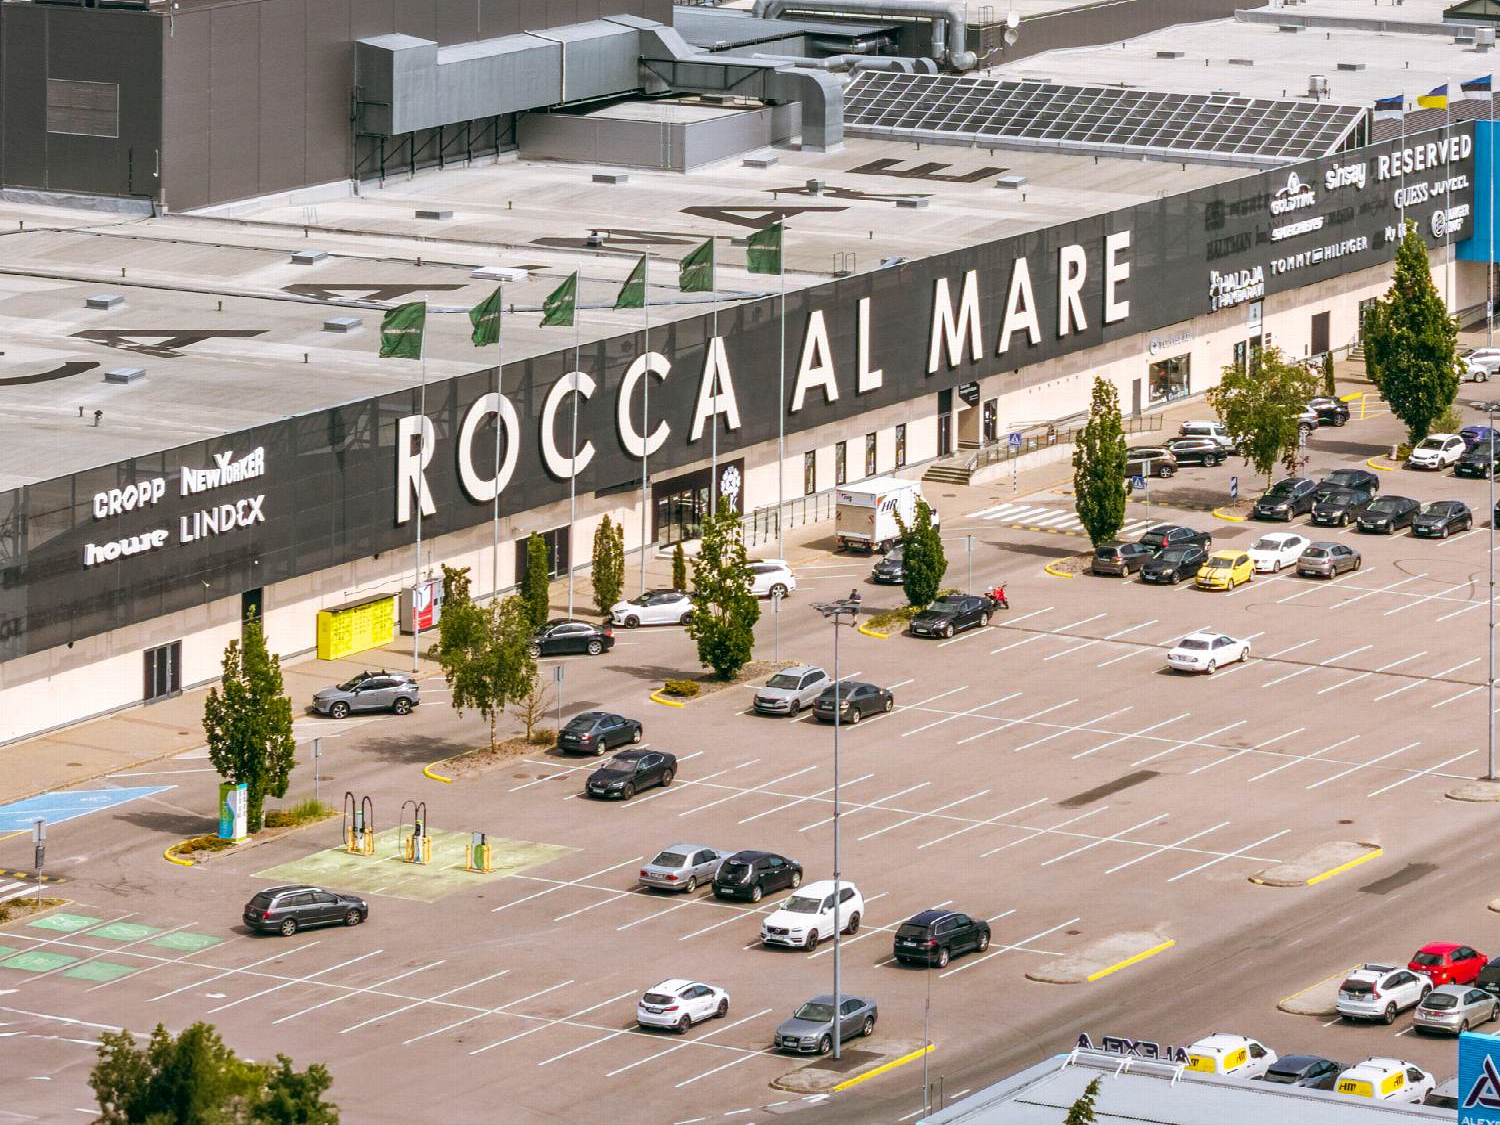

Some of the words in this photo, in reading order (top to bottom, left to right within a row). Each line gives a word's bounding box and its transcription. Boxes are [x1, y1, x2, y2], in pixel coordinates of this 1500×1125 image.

[1325, 162, 1366, 190] sinsay
[1377, 134, 1472, 180] RESERVED
[1394, 181, 1428, 209] GUESS
[1270, 249, 1311, 275] TOMMY
[1323, 236, 1368, 260] HILFIGER
[1218, 265, 1265, 293] HALDJA
[396, 336, 741, 524] ROCCA
[791, 296, 882, 412] AL
[927, 230, 1130, 374] MARE
[93, 477, 165, 518] CROPP
[179, 494, 265, 543] LINDEX
[84, 529, 169, 566] house
